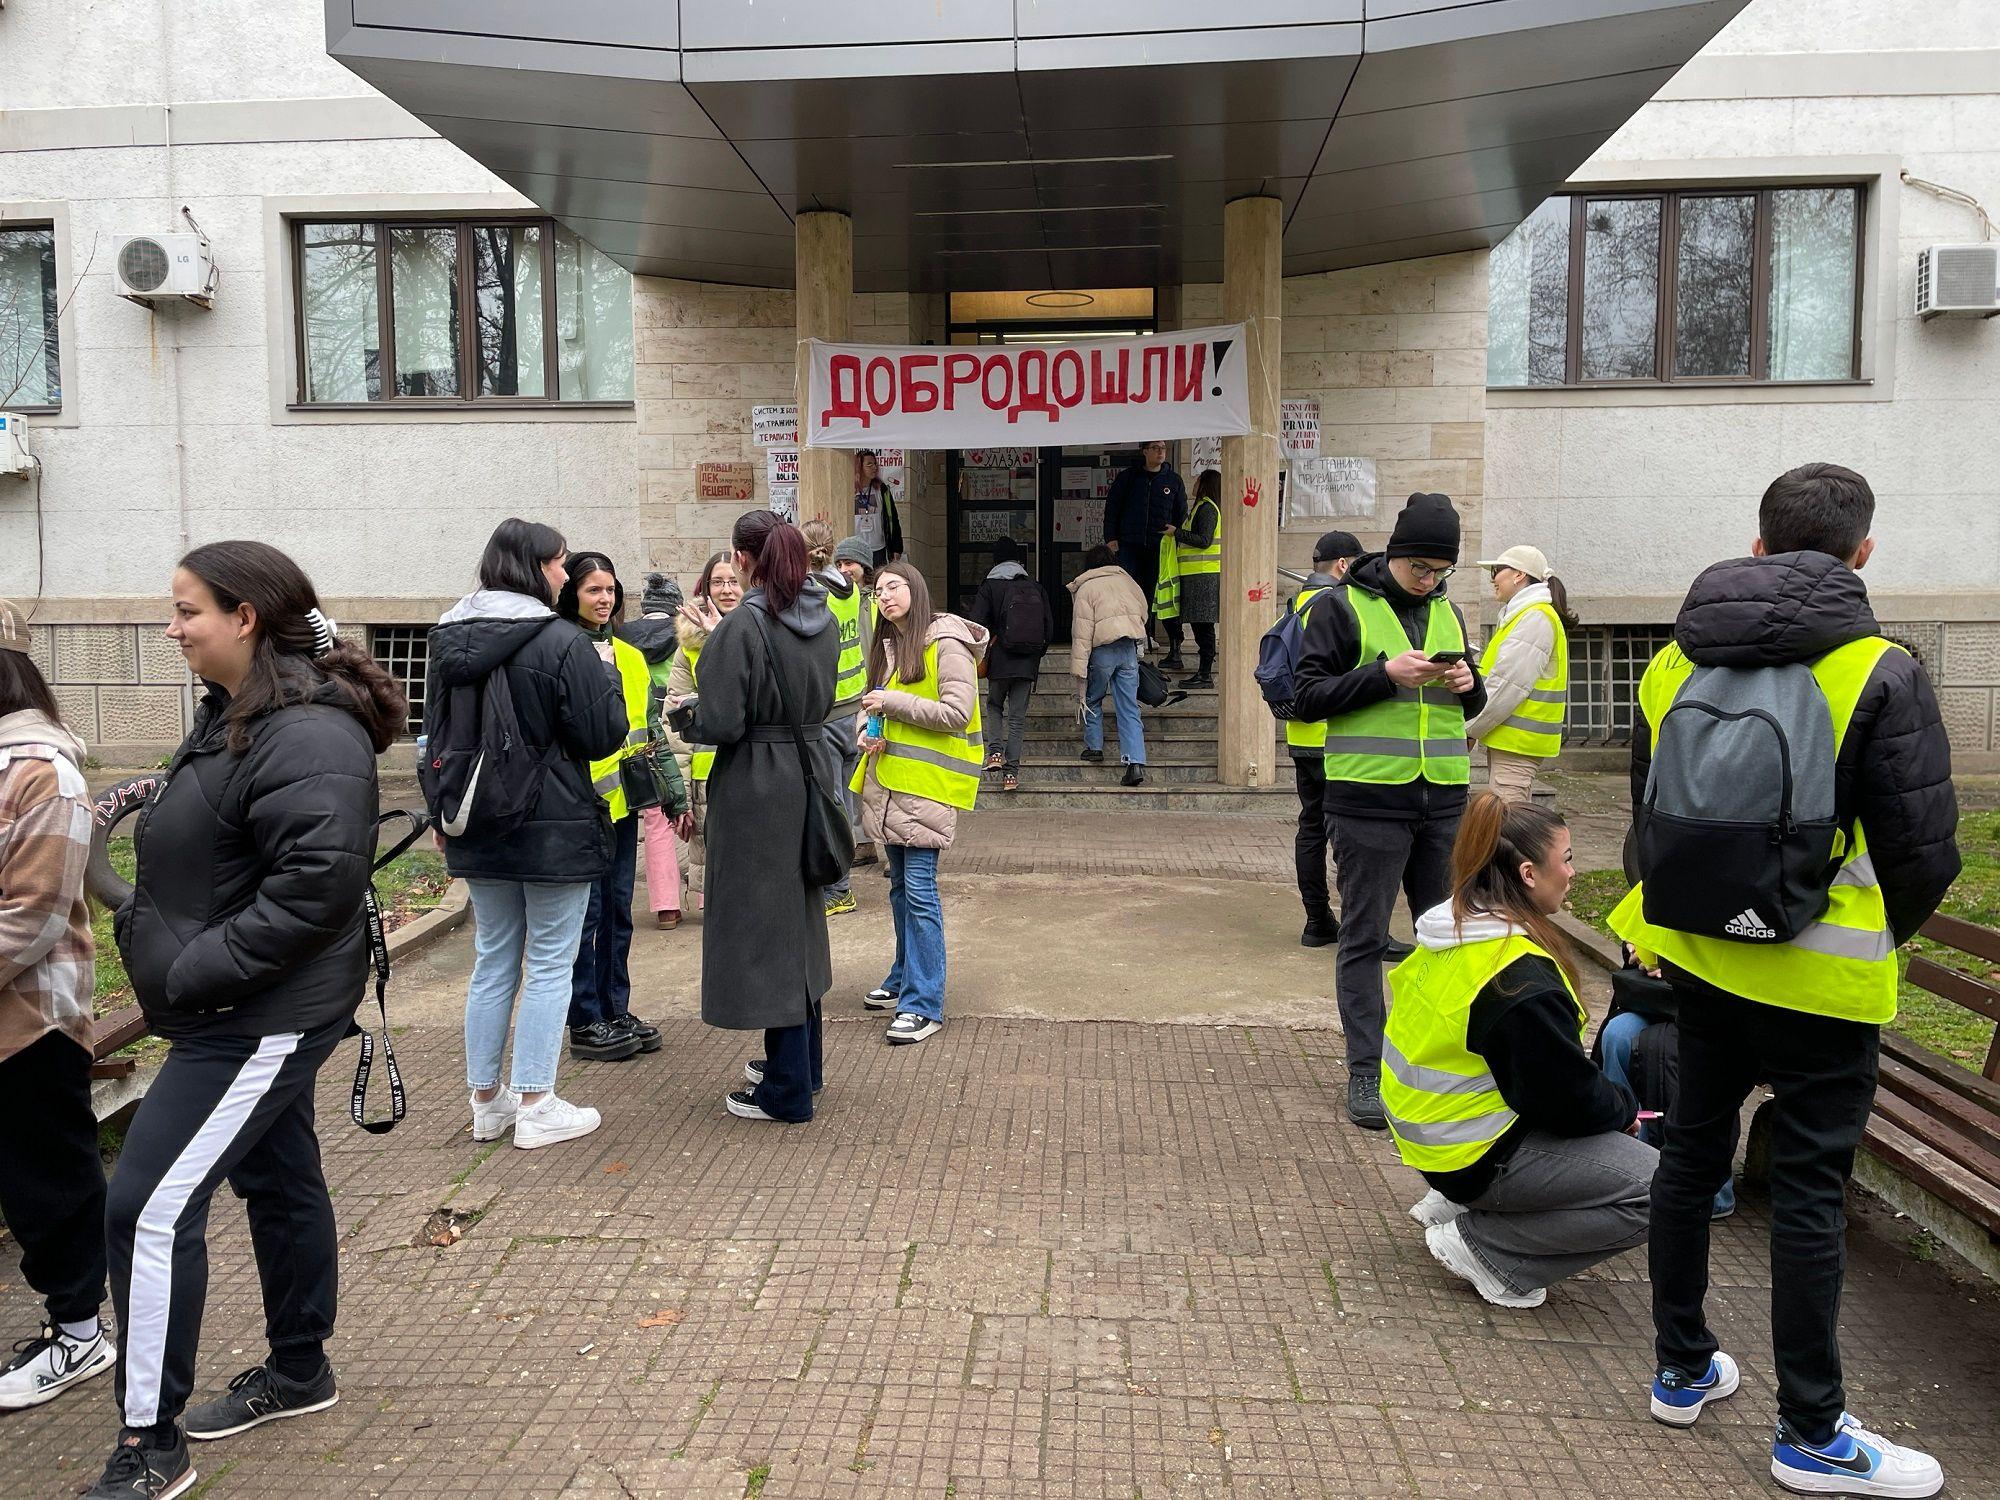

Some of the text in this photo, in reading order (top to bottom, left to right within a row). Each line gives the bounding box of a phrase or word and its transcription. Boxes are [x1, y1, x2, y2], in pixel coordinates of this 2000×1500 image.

[177, 255, 190, 263] LG
[821, 339, 1234, 429] ДОБРОДОШЛИ!
[754, 407, 778, 415] СИСТЕМ
[754, 421, 766, 429] МИ
[1283, 420, 1318, 430] PRAVDA
[1286, 439, 1315, 449] GRADI
[775, 454, 788, 462] ZUB
[983, 454, 1021, 467] УЛАЗА
[702, 463, 733, 473] ПРАВДА
[1302, 459, 1363, 471] НЕ ТРАЖИМО
[702, 473, 719, 484] ЛЕК
[1313, 483, 1355, 493] ТРАЖИМО
[369, 915, 382, 943] J'AIMER
[1724, 924, 1777, 938] adidas
[388, 1058, 400, 1087] J'AIMER
[353, 1035, 372, 1123] J'AIMER J'AIMER J'AIMER
[1661, 1378, 1677, 1387] AIR
